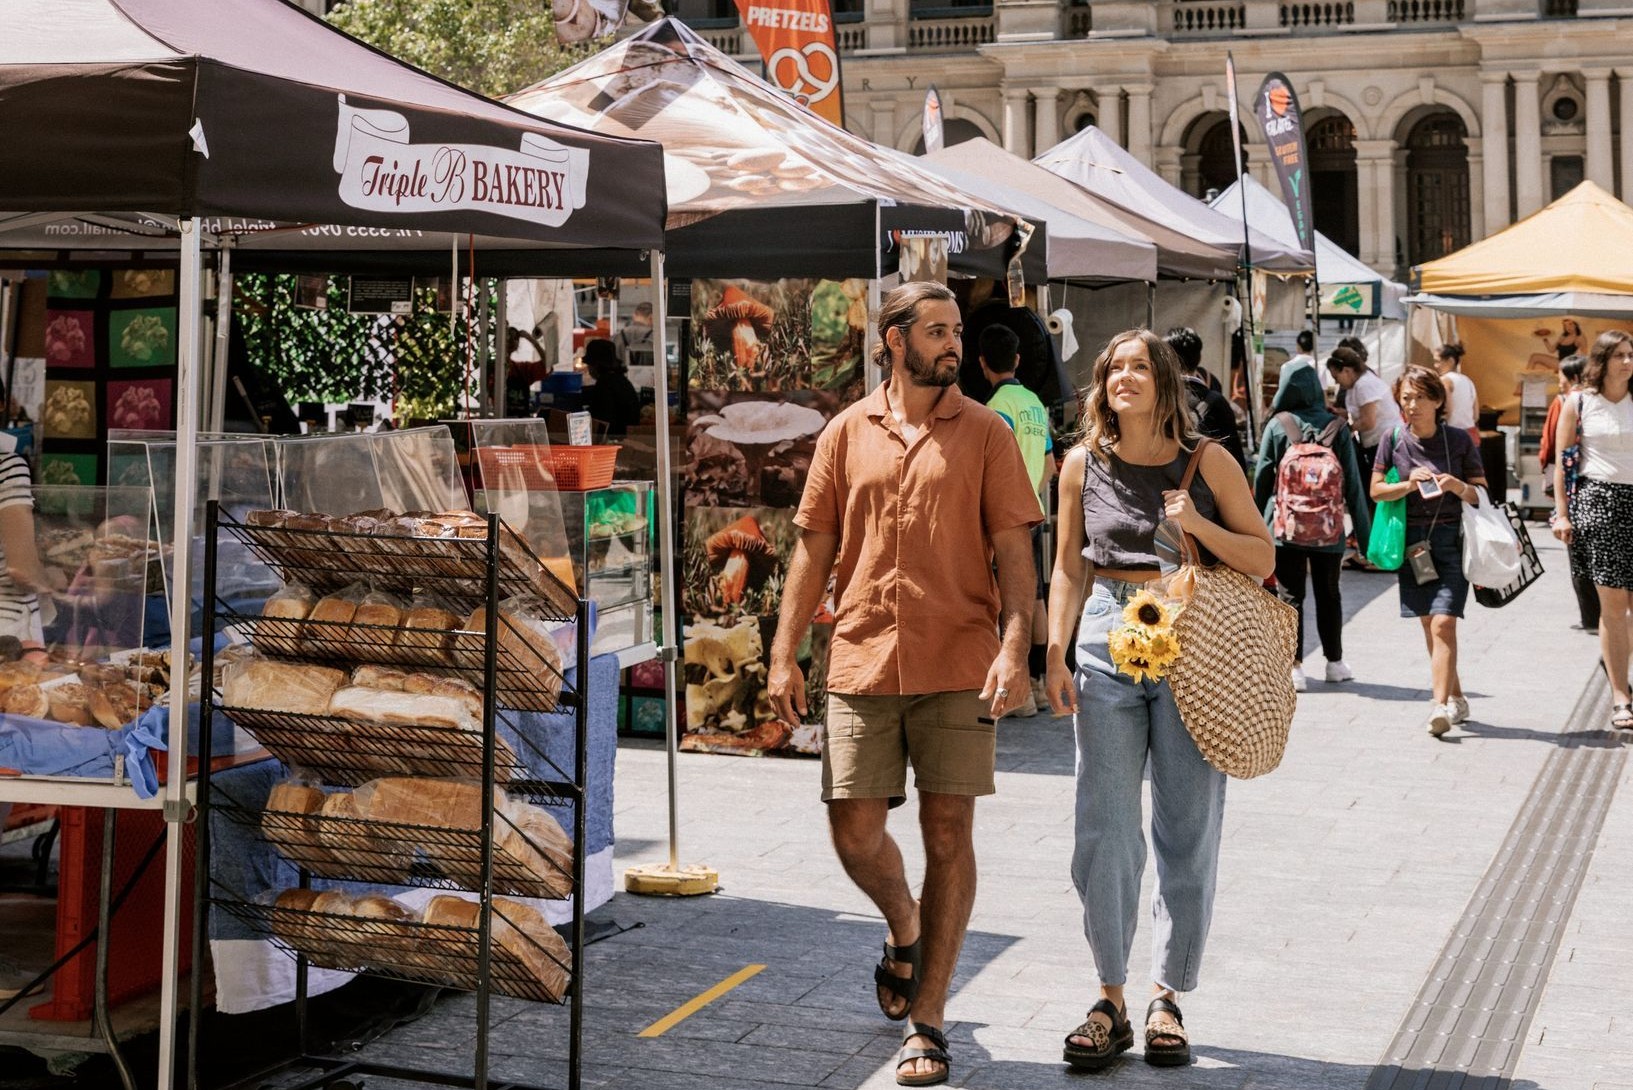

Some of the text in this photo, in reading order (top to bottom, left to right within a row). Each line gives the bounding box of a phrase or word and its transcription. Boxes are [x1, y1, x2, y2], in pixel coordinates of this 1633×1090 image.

[747, 6, 829, 33] PRETZELS
[361, 146, 566, 210] Triple B BAKERY
